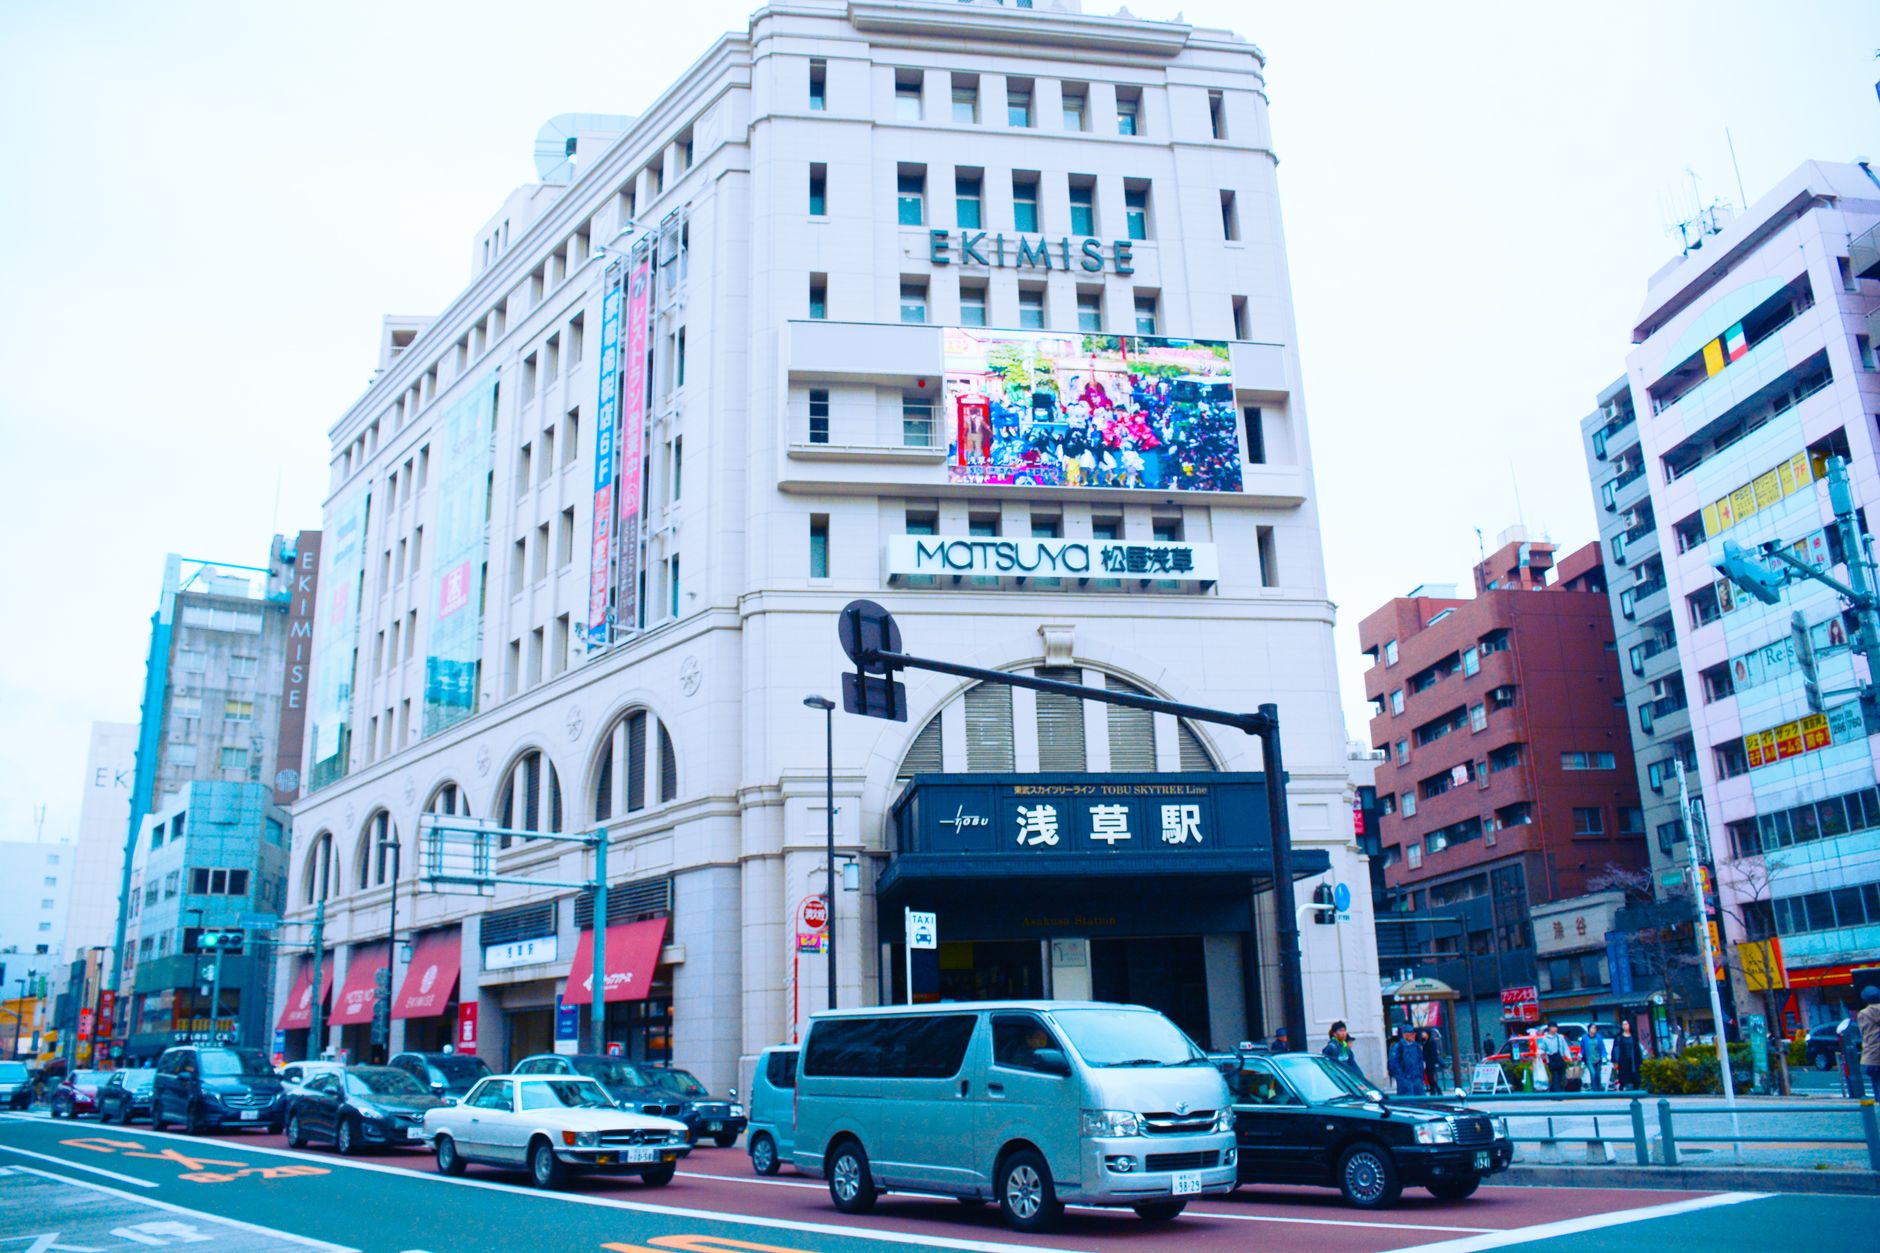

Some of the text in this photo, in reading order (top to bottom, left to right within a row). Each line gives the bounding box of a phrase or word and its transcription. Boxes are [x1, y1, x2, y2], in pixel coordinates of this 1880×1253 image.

[930, 229, 1134, 275] EKIMISE
[1101, 545, 1194, 574] 松屋浅草
[288, 551, 314, 709] EKIMISE
[1013, 785, 1208, 795] 東武スカイツリーライン TOBU SKYTREE Line
[1016, 803, 1204, 846] 浅草駅
[912, 914, 934, 925] TAXI
[1075, 915, 1117, 927] Station
[1178, 1180, 1200, 1193] 98-29
